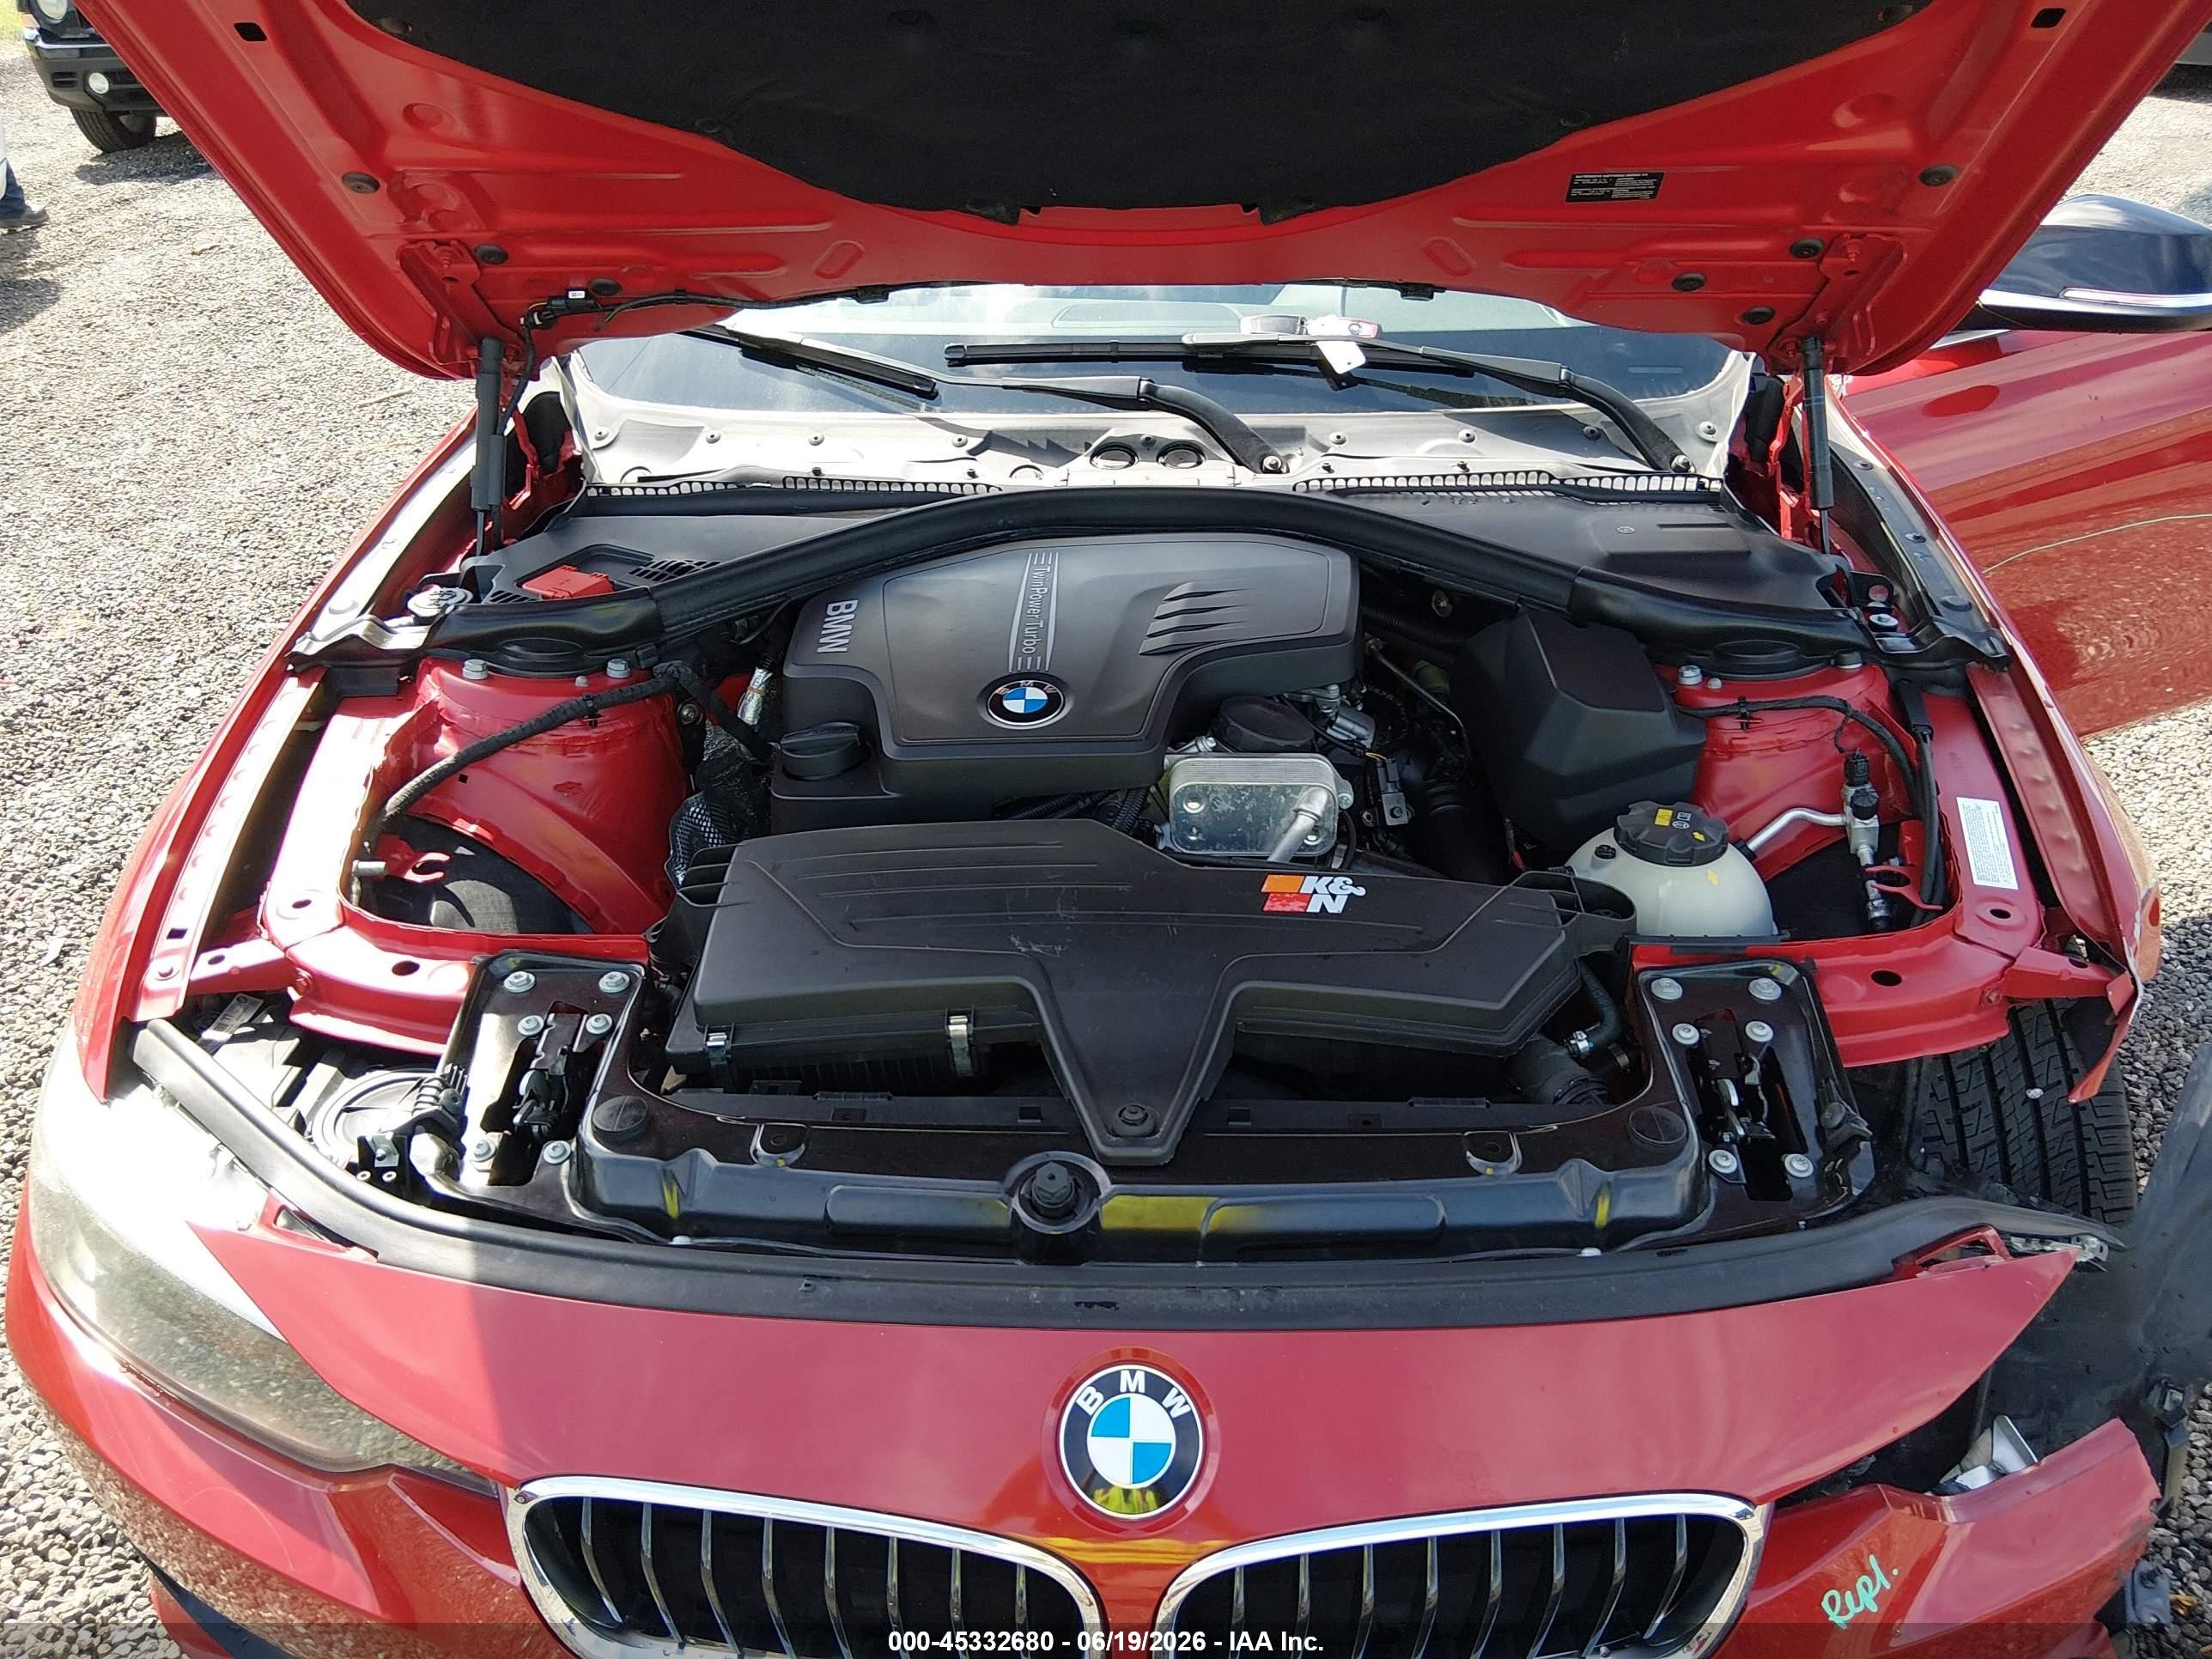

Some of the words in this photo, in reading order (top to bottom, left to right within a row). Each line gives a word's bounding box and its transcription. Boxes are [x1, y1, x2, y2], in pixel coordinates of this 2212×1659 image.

[817, 599, 859, 654] BMW
[994, 680, 1058, 696] BMW
[1075, 1370, 1192, 1419] BMW
